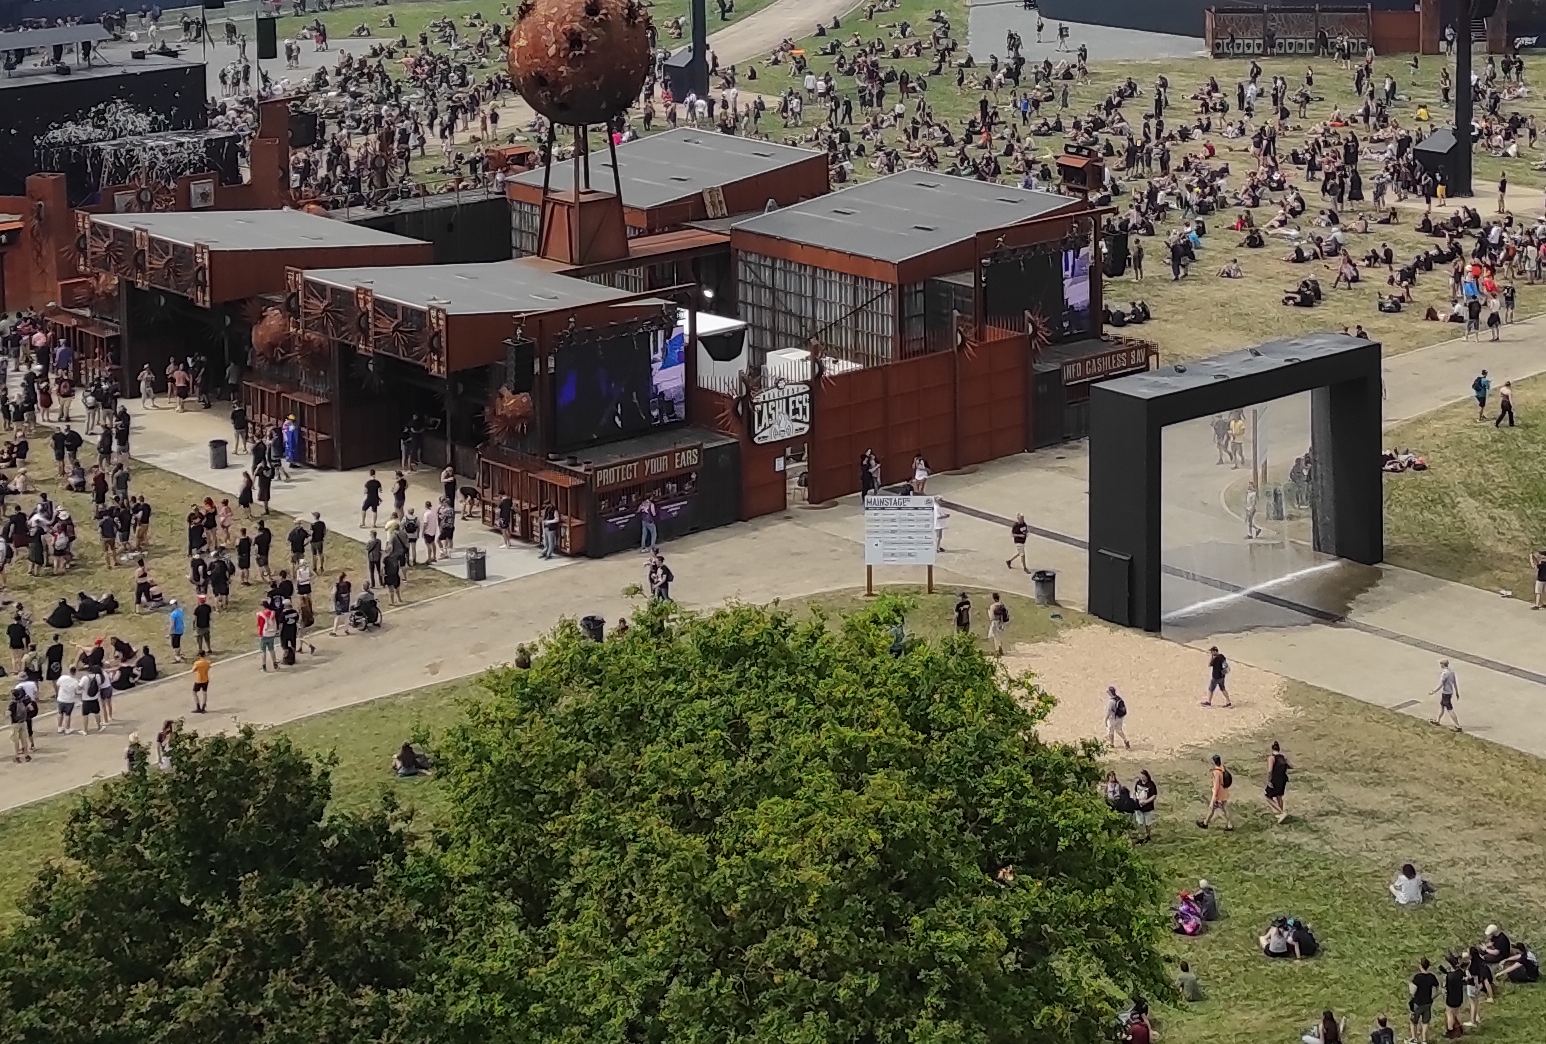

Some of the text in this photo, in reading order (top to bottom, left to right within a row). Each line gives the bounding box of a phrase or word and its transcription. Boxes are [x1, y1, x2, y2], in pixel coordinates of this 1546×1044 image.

[1063, 362, 1083, 380] INFO
[1085, 352, 1127, 375] CASHLESS
[754, 393, 810, 435] CASHLESS
[596, 448, 699, 488] PROTECT YOUR EARS
[866, 497, 906, 507] MAINSTAGE
